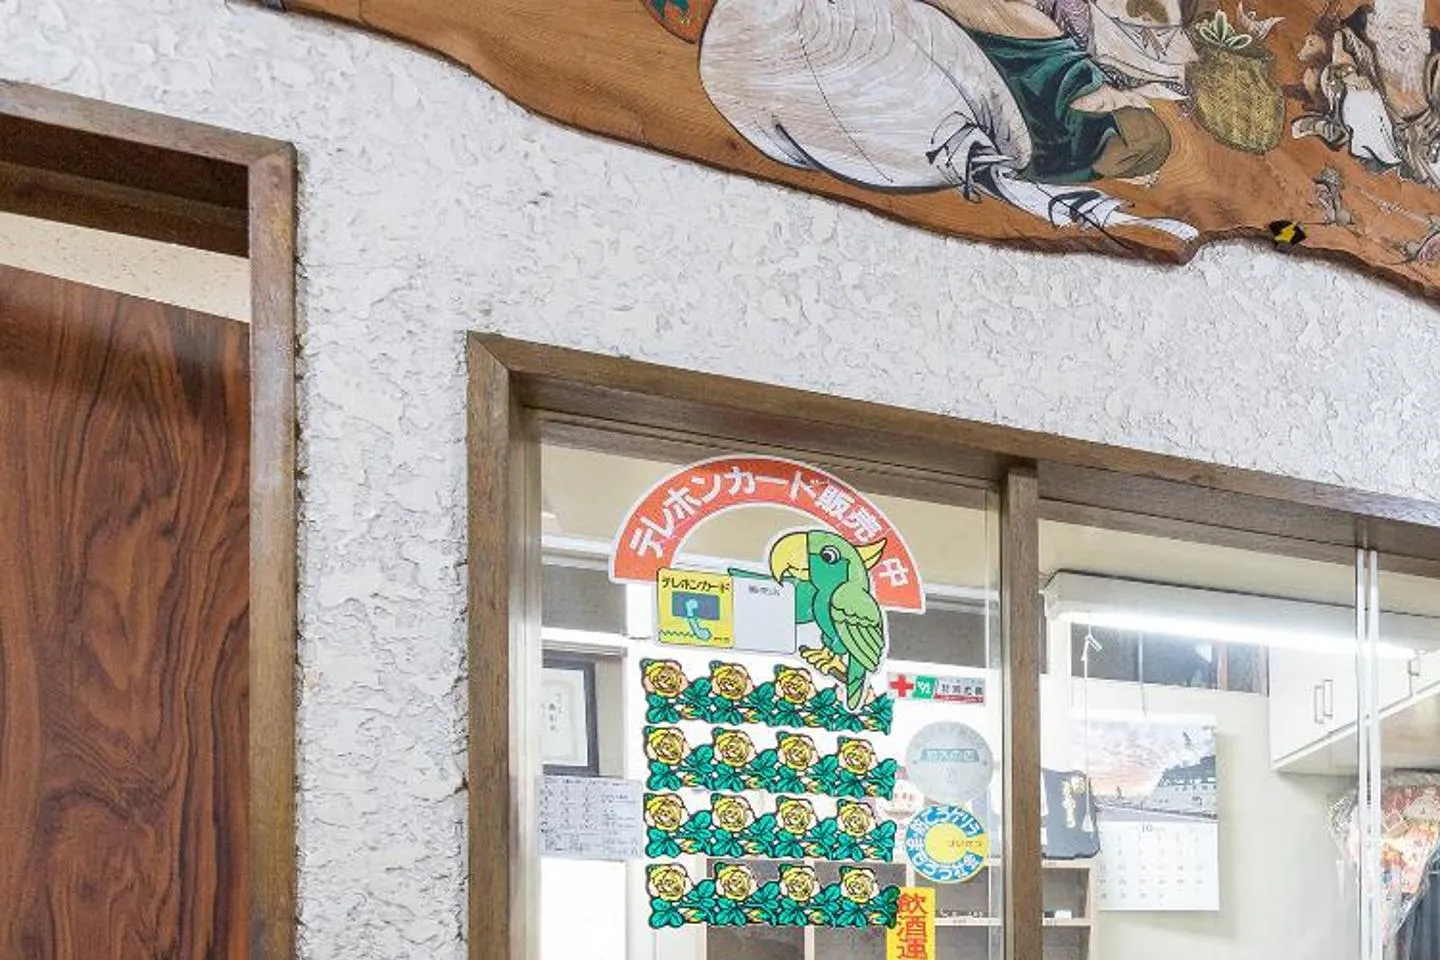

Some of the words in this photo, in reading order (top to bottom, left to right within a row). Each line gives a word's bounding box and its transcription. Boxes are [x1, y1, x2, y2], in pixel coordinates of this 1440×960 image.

[629, 466, 909, 587] テレホンカード販売中
[661, 576, 730, 594] テレホンカード
